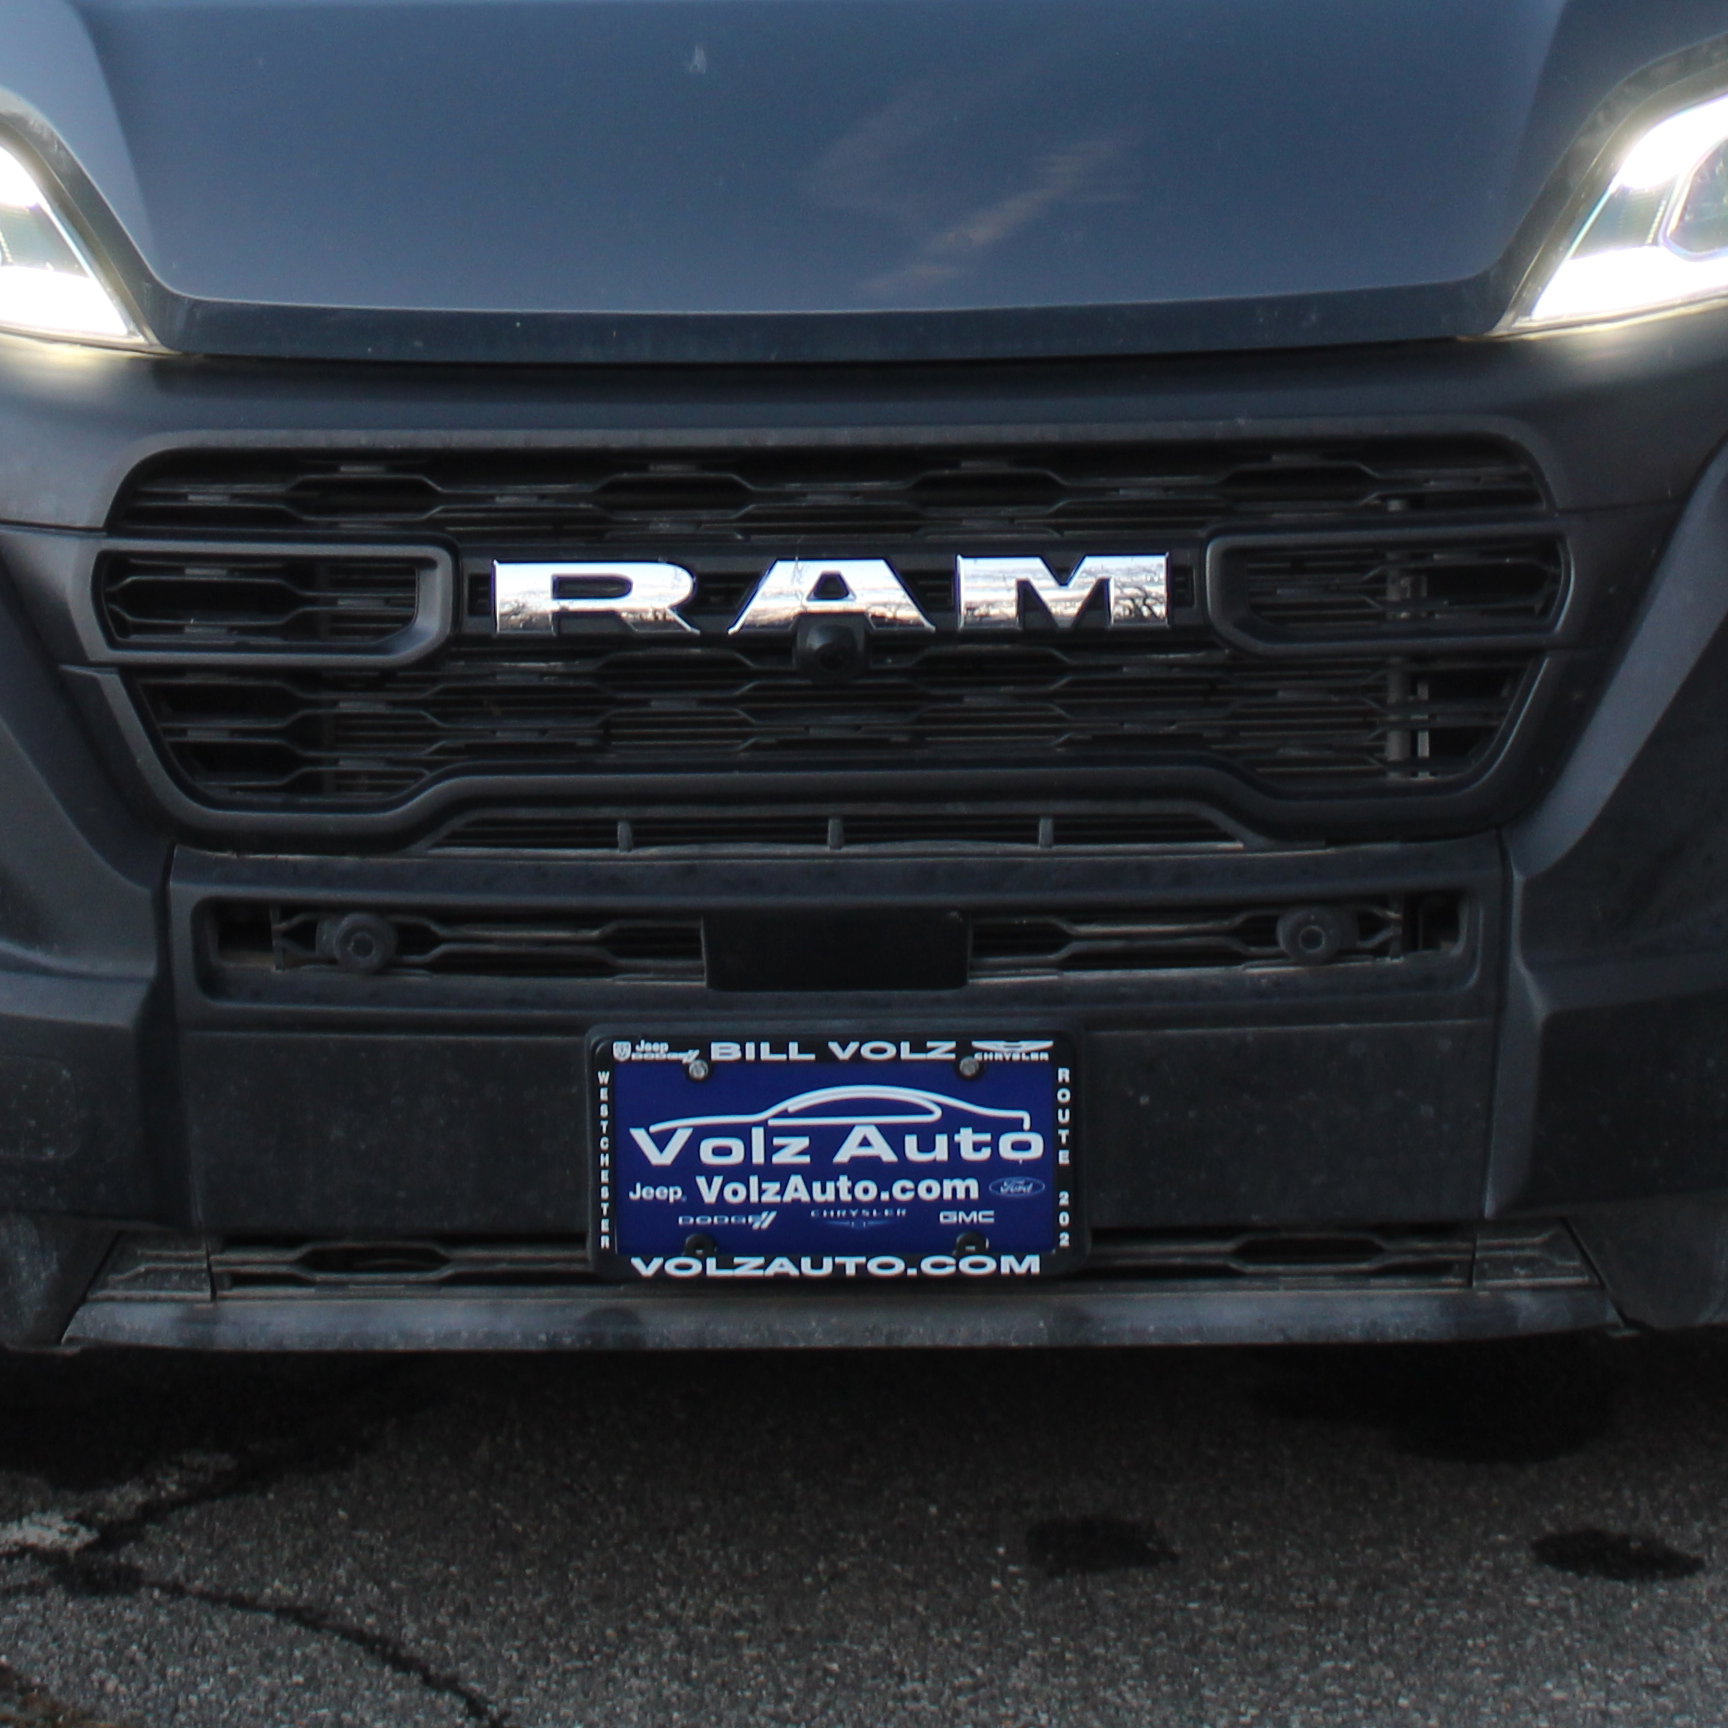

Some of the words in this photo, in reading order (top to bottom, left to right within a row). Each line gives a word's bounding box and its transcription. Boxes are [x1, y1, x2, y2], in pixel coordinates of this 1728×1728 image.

[492, 552, 1170, 636] RAM
[635, 1040, 669, 1053] Jeep
[710, 1041, 816, 1061] BILL
[827, 1041, 957, 1061] VOLZ
[974, 1052, 1050, 1061] CHRYSLER
[1057, 1067, 1071, 1165] ROUTE
[629, 1126, 811, 1166] Volz
[832, 1124, 1045, 1163] Auto
[597, 1070, 610, 1249] WESTCHESTER
[629, 1182, 683, 1203] Jeep
[695, 1175, 979, 1204] VolzAuto.com
[999, 1179, 1034, 1194] Ford
[678, 1215, 761, 1226] DODGE
[810, 1208, 907, 1217] CHRYSLER
[939, 1210, 995, 1223] GMC
[1058, 1191, 1070, 1247] 202
[630, 1254, 1040, 1277] VOLZAUTO.COM
